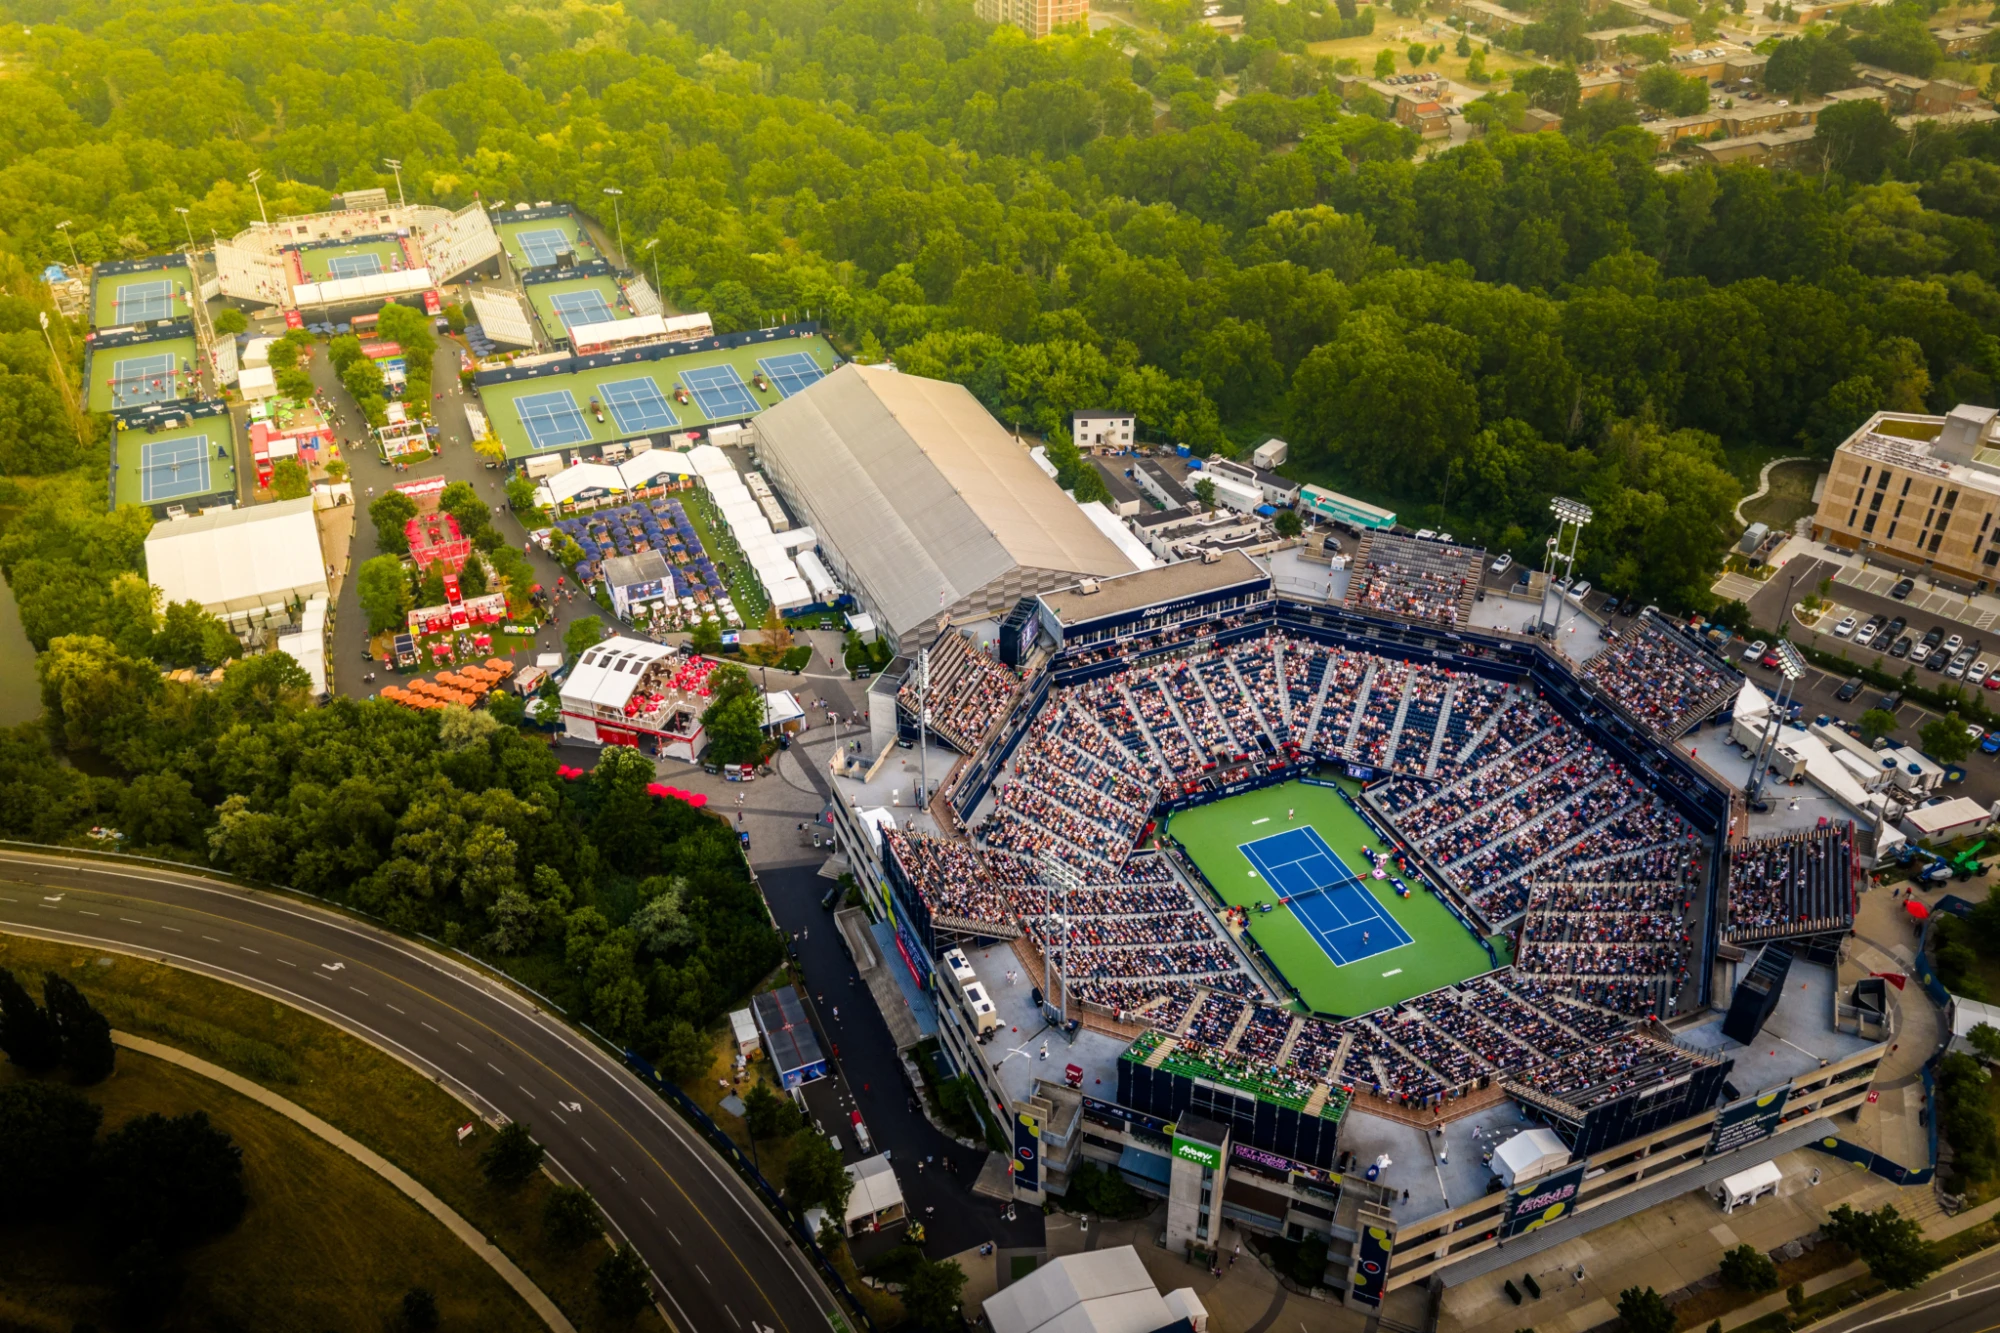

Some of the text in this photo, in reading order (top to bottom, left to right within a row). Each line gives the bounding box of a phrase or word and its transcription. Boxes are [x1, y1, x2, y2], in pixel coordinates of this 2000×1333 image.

[1142, 606, 1168, 618] Sobeys
[1179, 1145, 1213, 1160] Sobeys
[1179, 1151, 1212, 1165] STADIUM
[1259, 1152, 1287, 1165] YOUR
